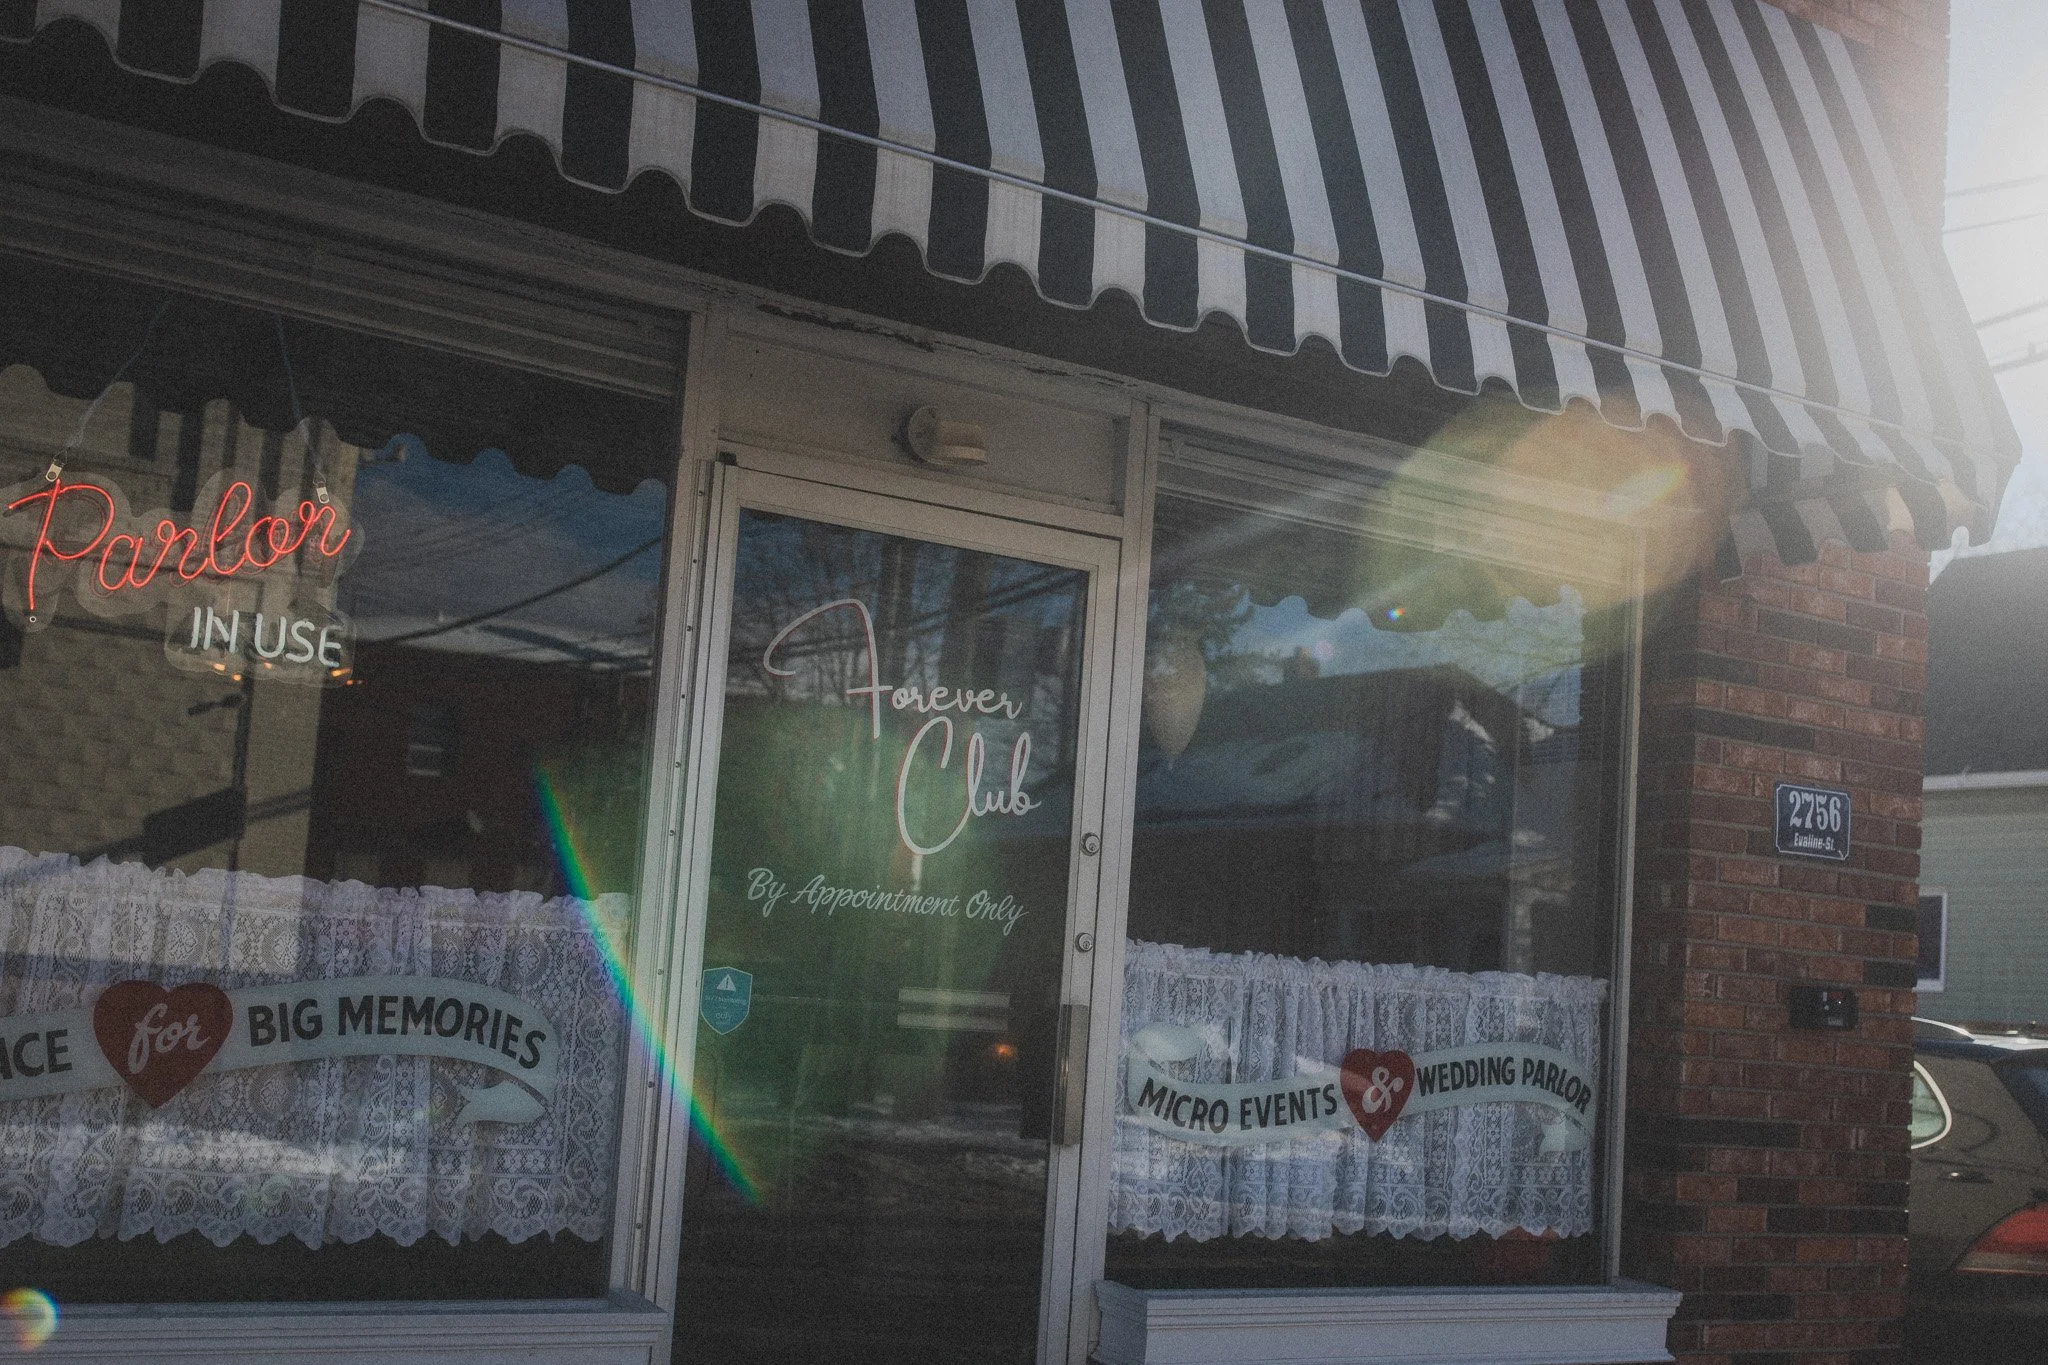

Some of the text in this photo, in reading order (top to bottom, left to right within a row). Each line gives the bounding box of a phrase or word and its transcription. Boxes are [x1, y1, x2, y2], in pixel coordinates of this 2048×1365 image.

[7, 478, 351, 611] Parlor
[190, 606, 344, 668] IN USE
[763, 598, 1022, 740] Forever
[897, 715, 1042, 855] Club
[1789, 791, 1841, 832] 2756
[747, 868, 1029, 936] By Appointment Only
[128, 1003, 210, 1074] for
[248, 1003, 323, 1048] BIG
[338, 995, 547, 1070] MEMORIES
[1137, 1056, 1591, 1134] MICRO EVENTS & WEDDING PARLOR
